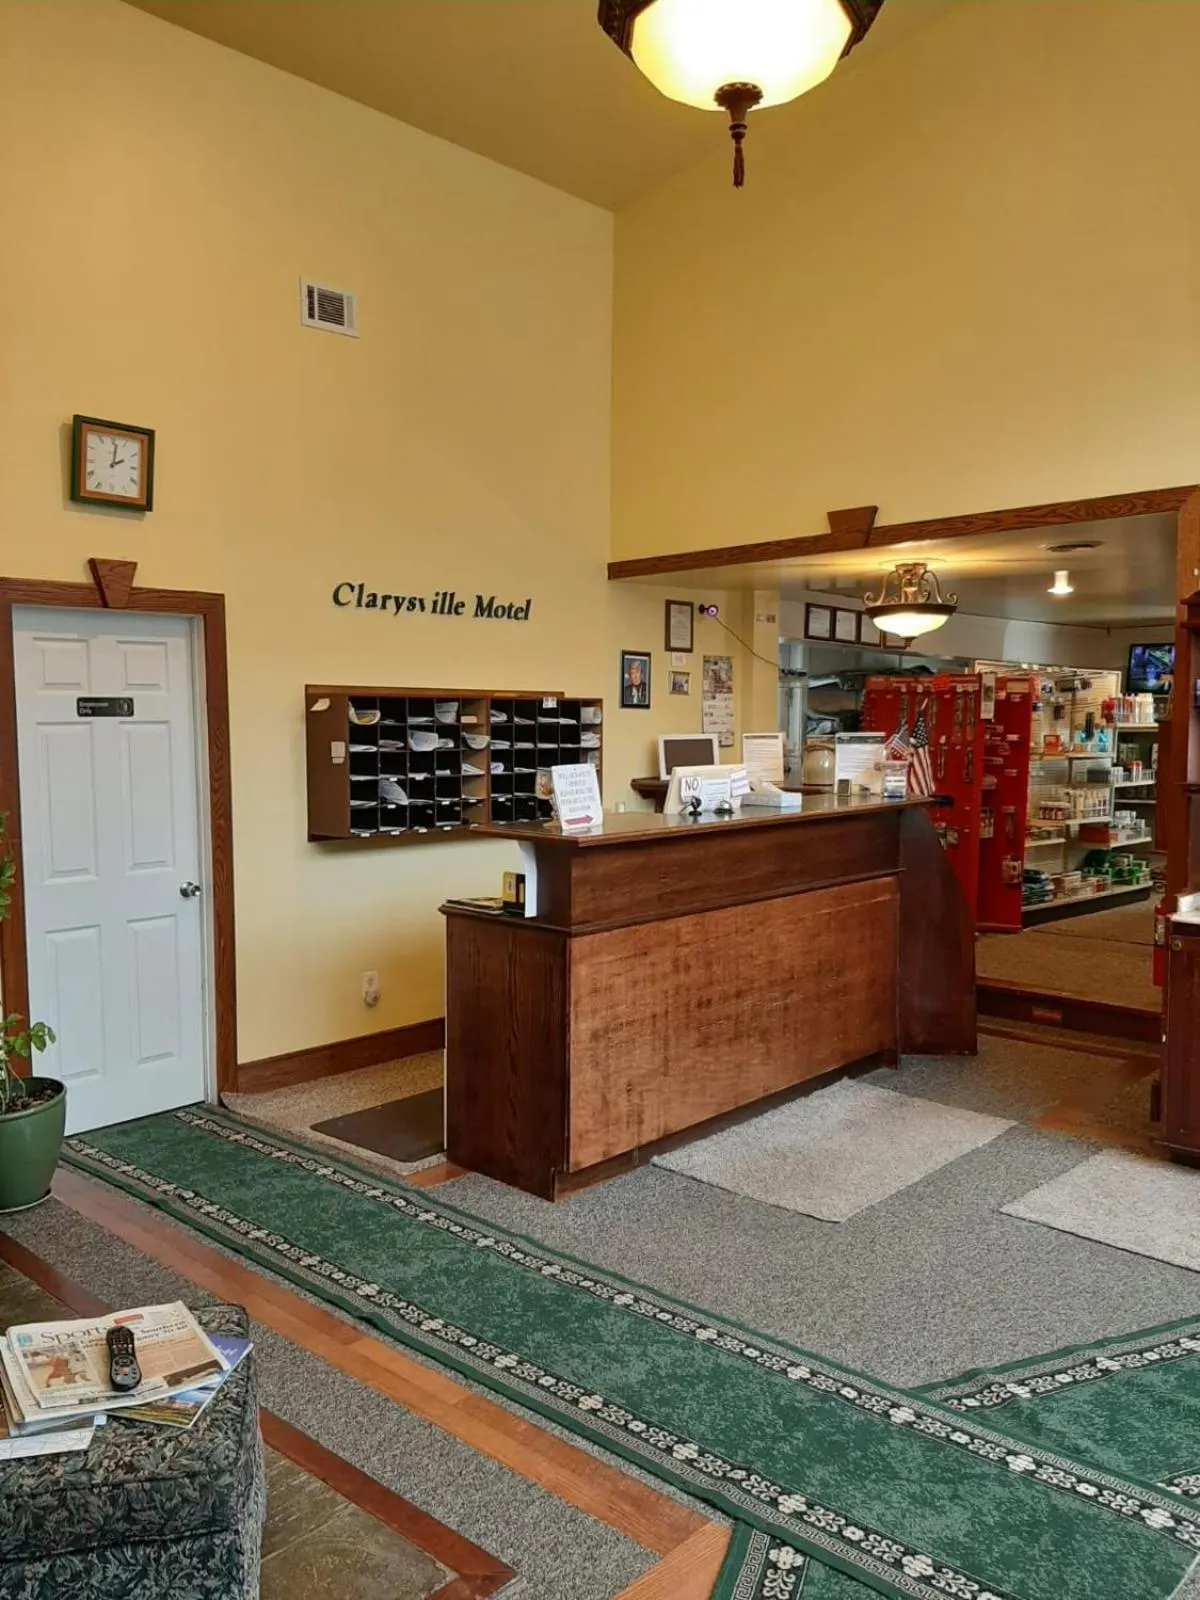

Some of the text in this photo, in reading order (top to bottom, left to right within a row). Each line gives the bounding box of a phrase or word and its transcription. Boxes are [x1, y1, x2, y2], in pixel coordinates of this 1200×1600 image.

[332, 582, 532, 621] Clarysville Motel
[684, 777, 699, 792] NO
